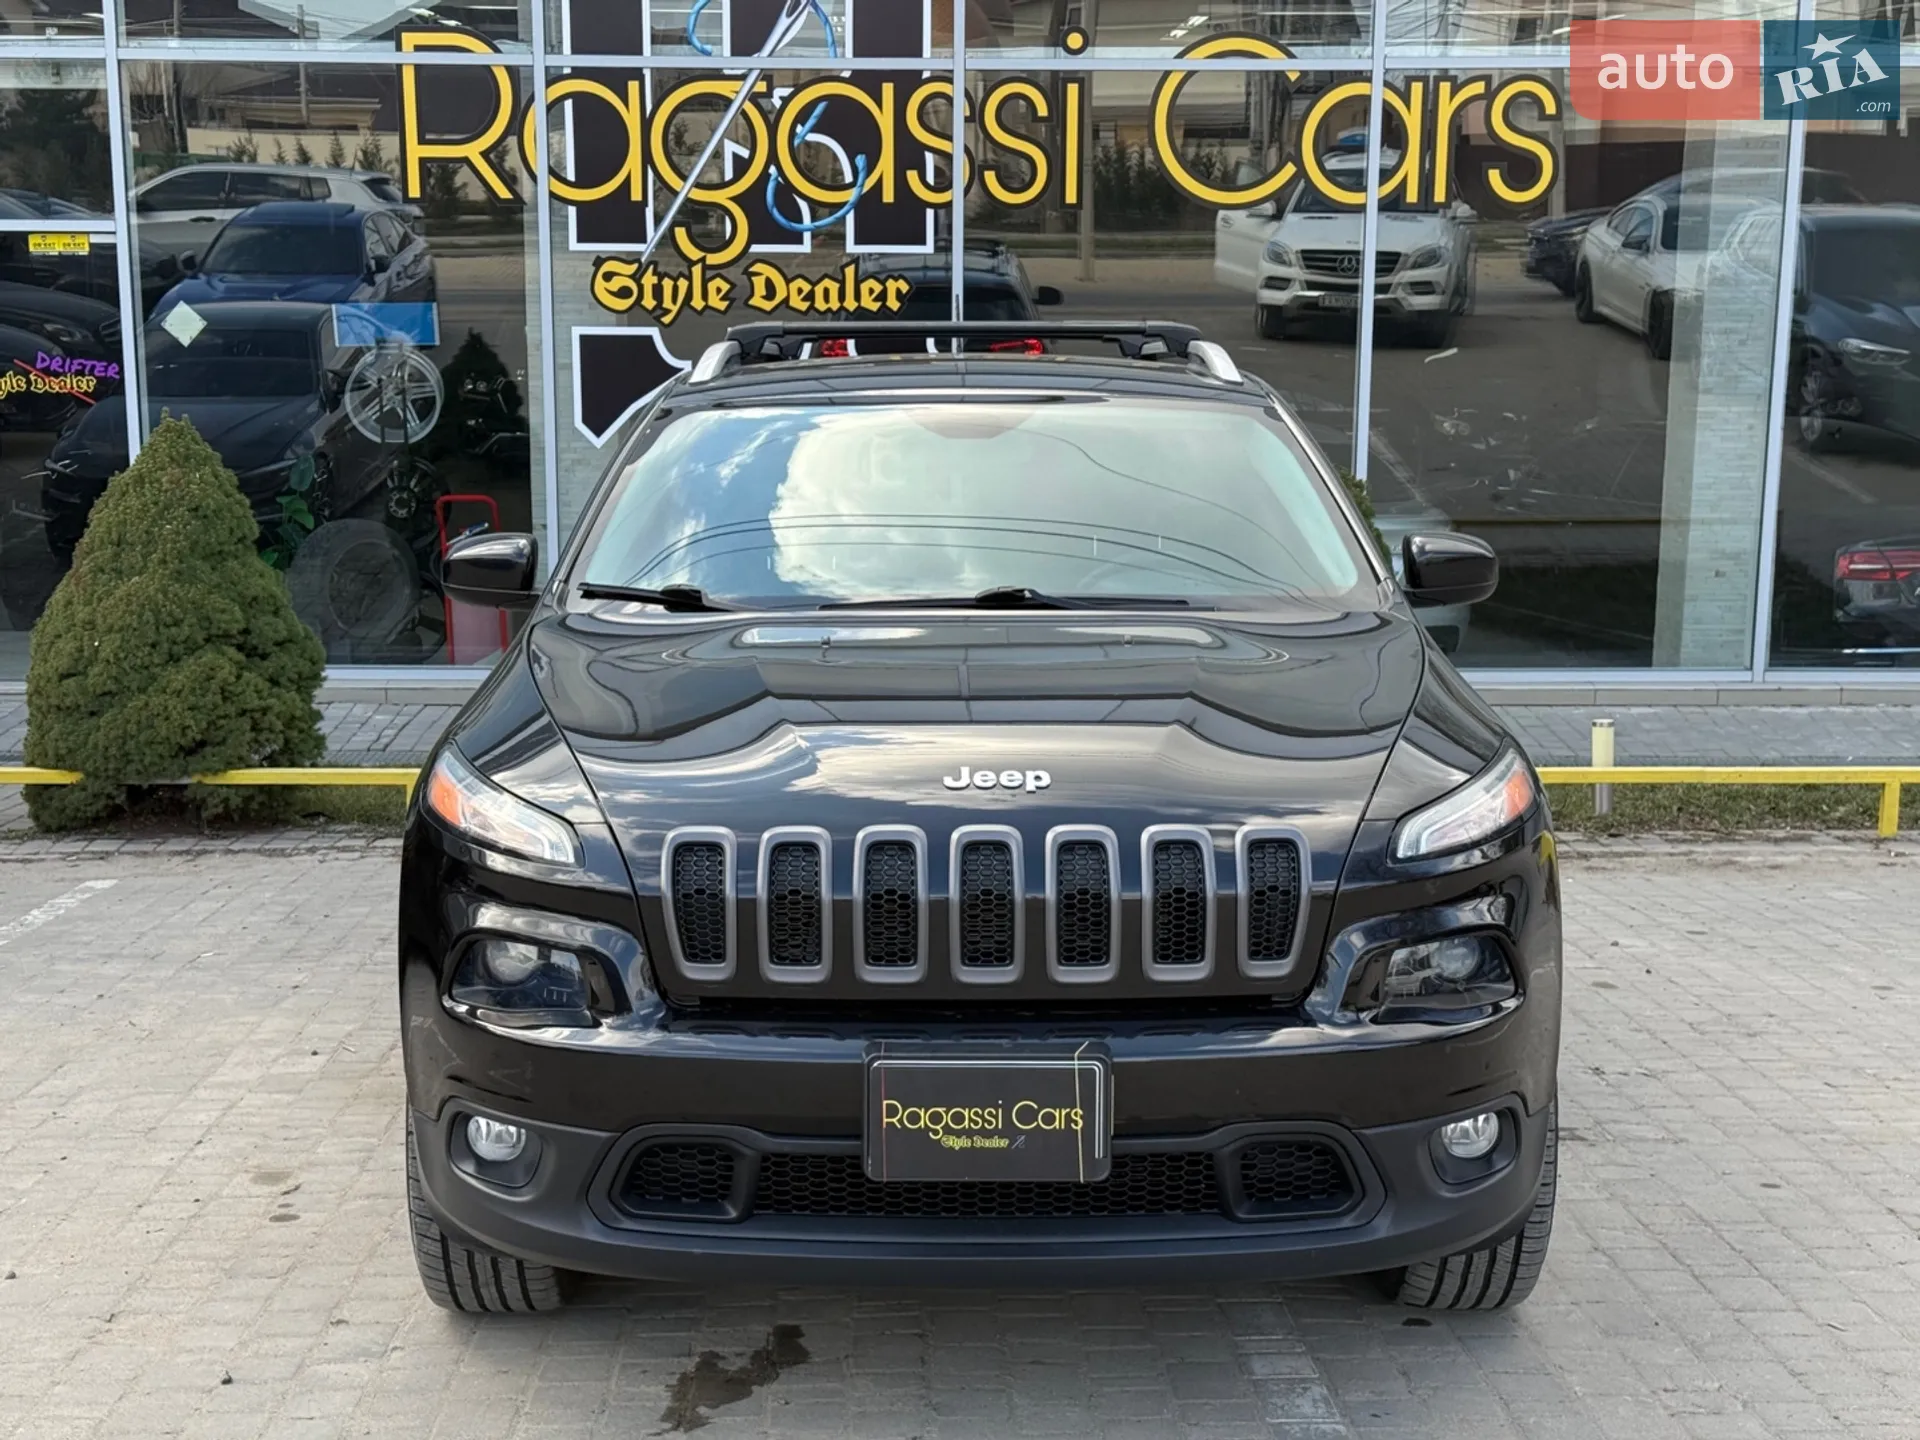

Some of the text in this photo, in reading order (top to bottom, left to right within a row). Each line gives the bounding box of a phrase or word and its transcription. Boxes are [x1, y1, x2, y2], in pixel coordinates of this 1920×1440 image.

[400, 31, 1556, 264] Ragassi Cars
[593, 259, 912, 326] Style Dealer
[29, 370, 97, 394] Dealer
[35, 350, 121, 379] DRIFTER
[942, 766, 1052, 794] Jeep
[881, 1099, 1084, 1140] Ragassi Cars
